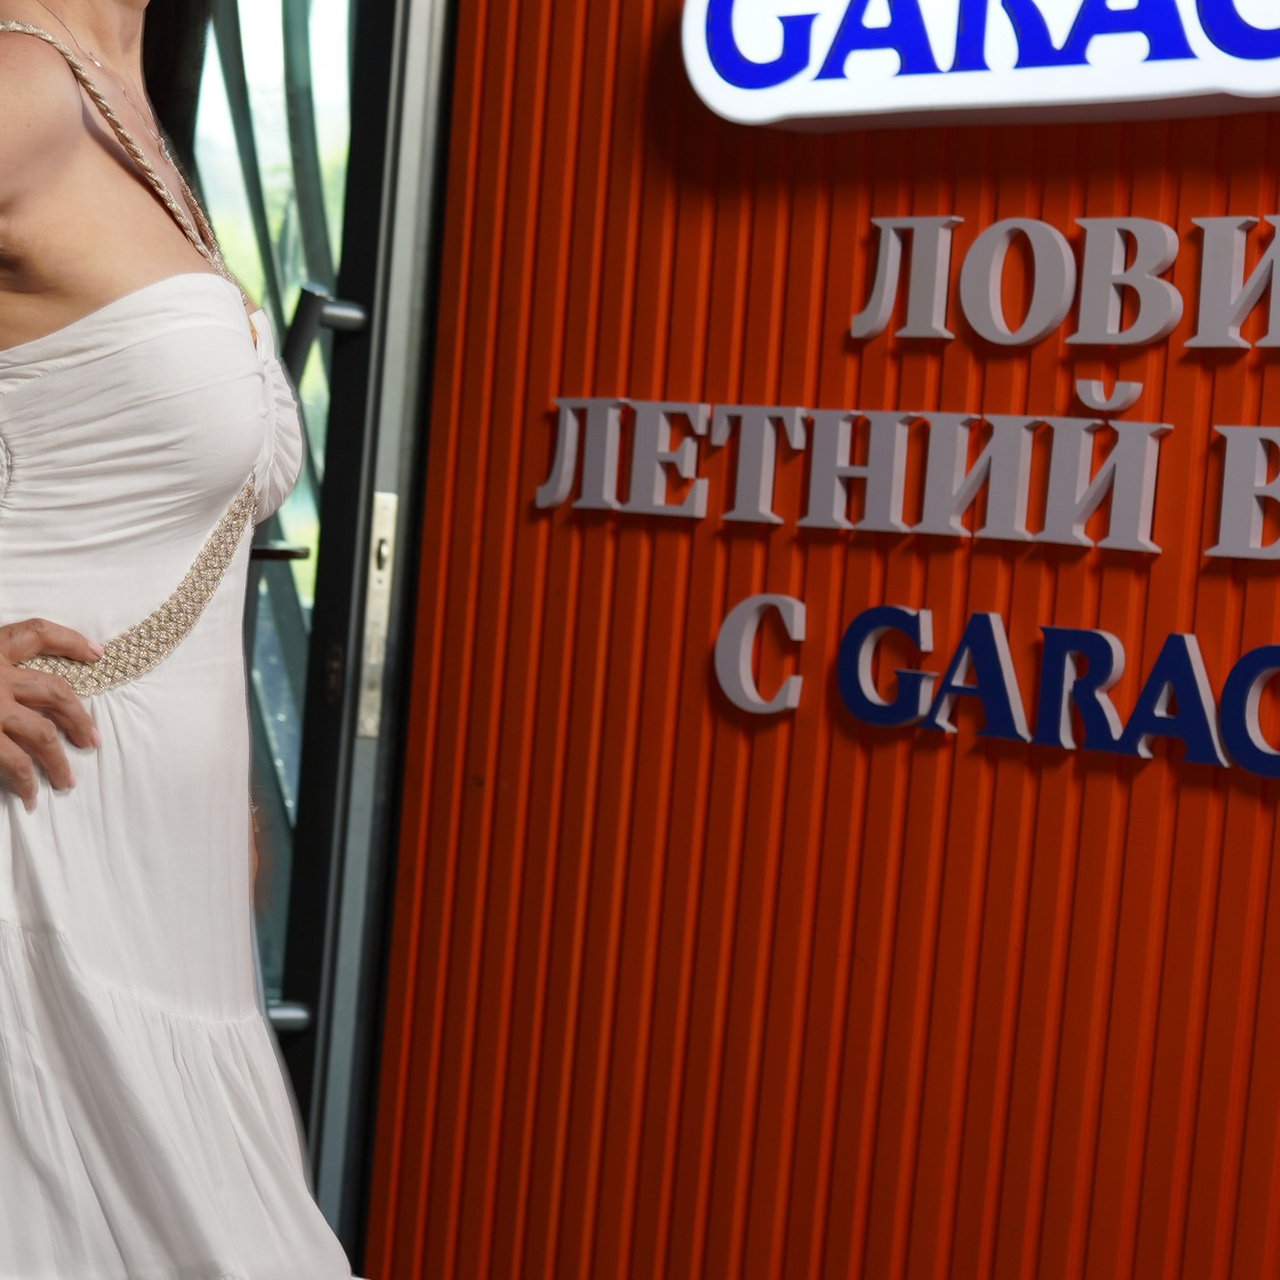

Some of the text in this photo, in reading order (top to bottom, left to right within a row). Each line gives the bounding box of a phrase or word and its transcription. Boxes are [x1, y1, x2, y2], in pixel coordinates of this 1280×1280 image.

[850, 214, 1280, 350] ЛОВИ
[535, 379, 1176, 555] ЛЕТНИЙ
[713, 592, 807, 715] С
